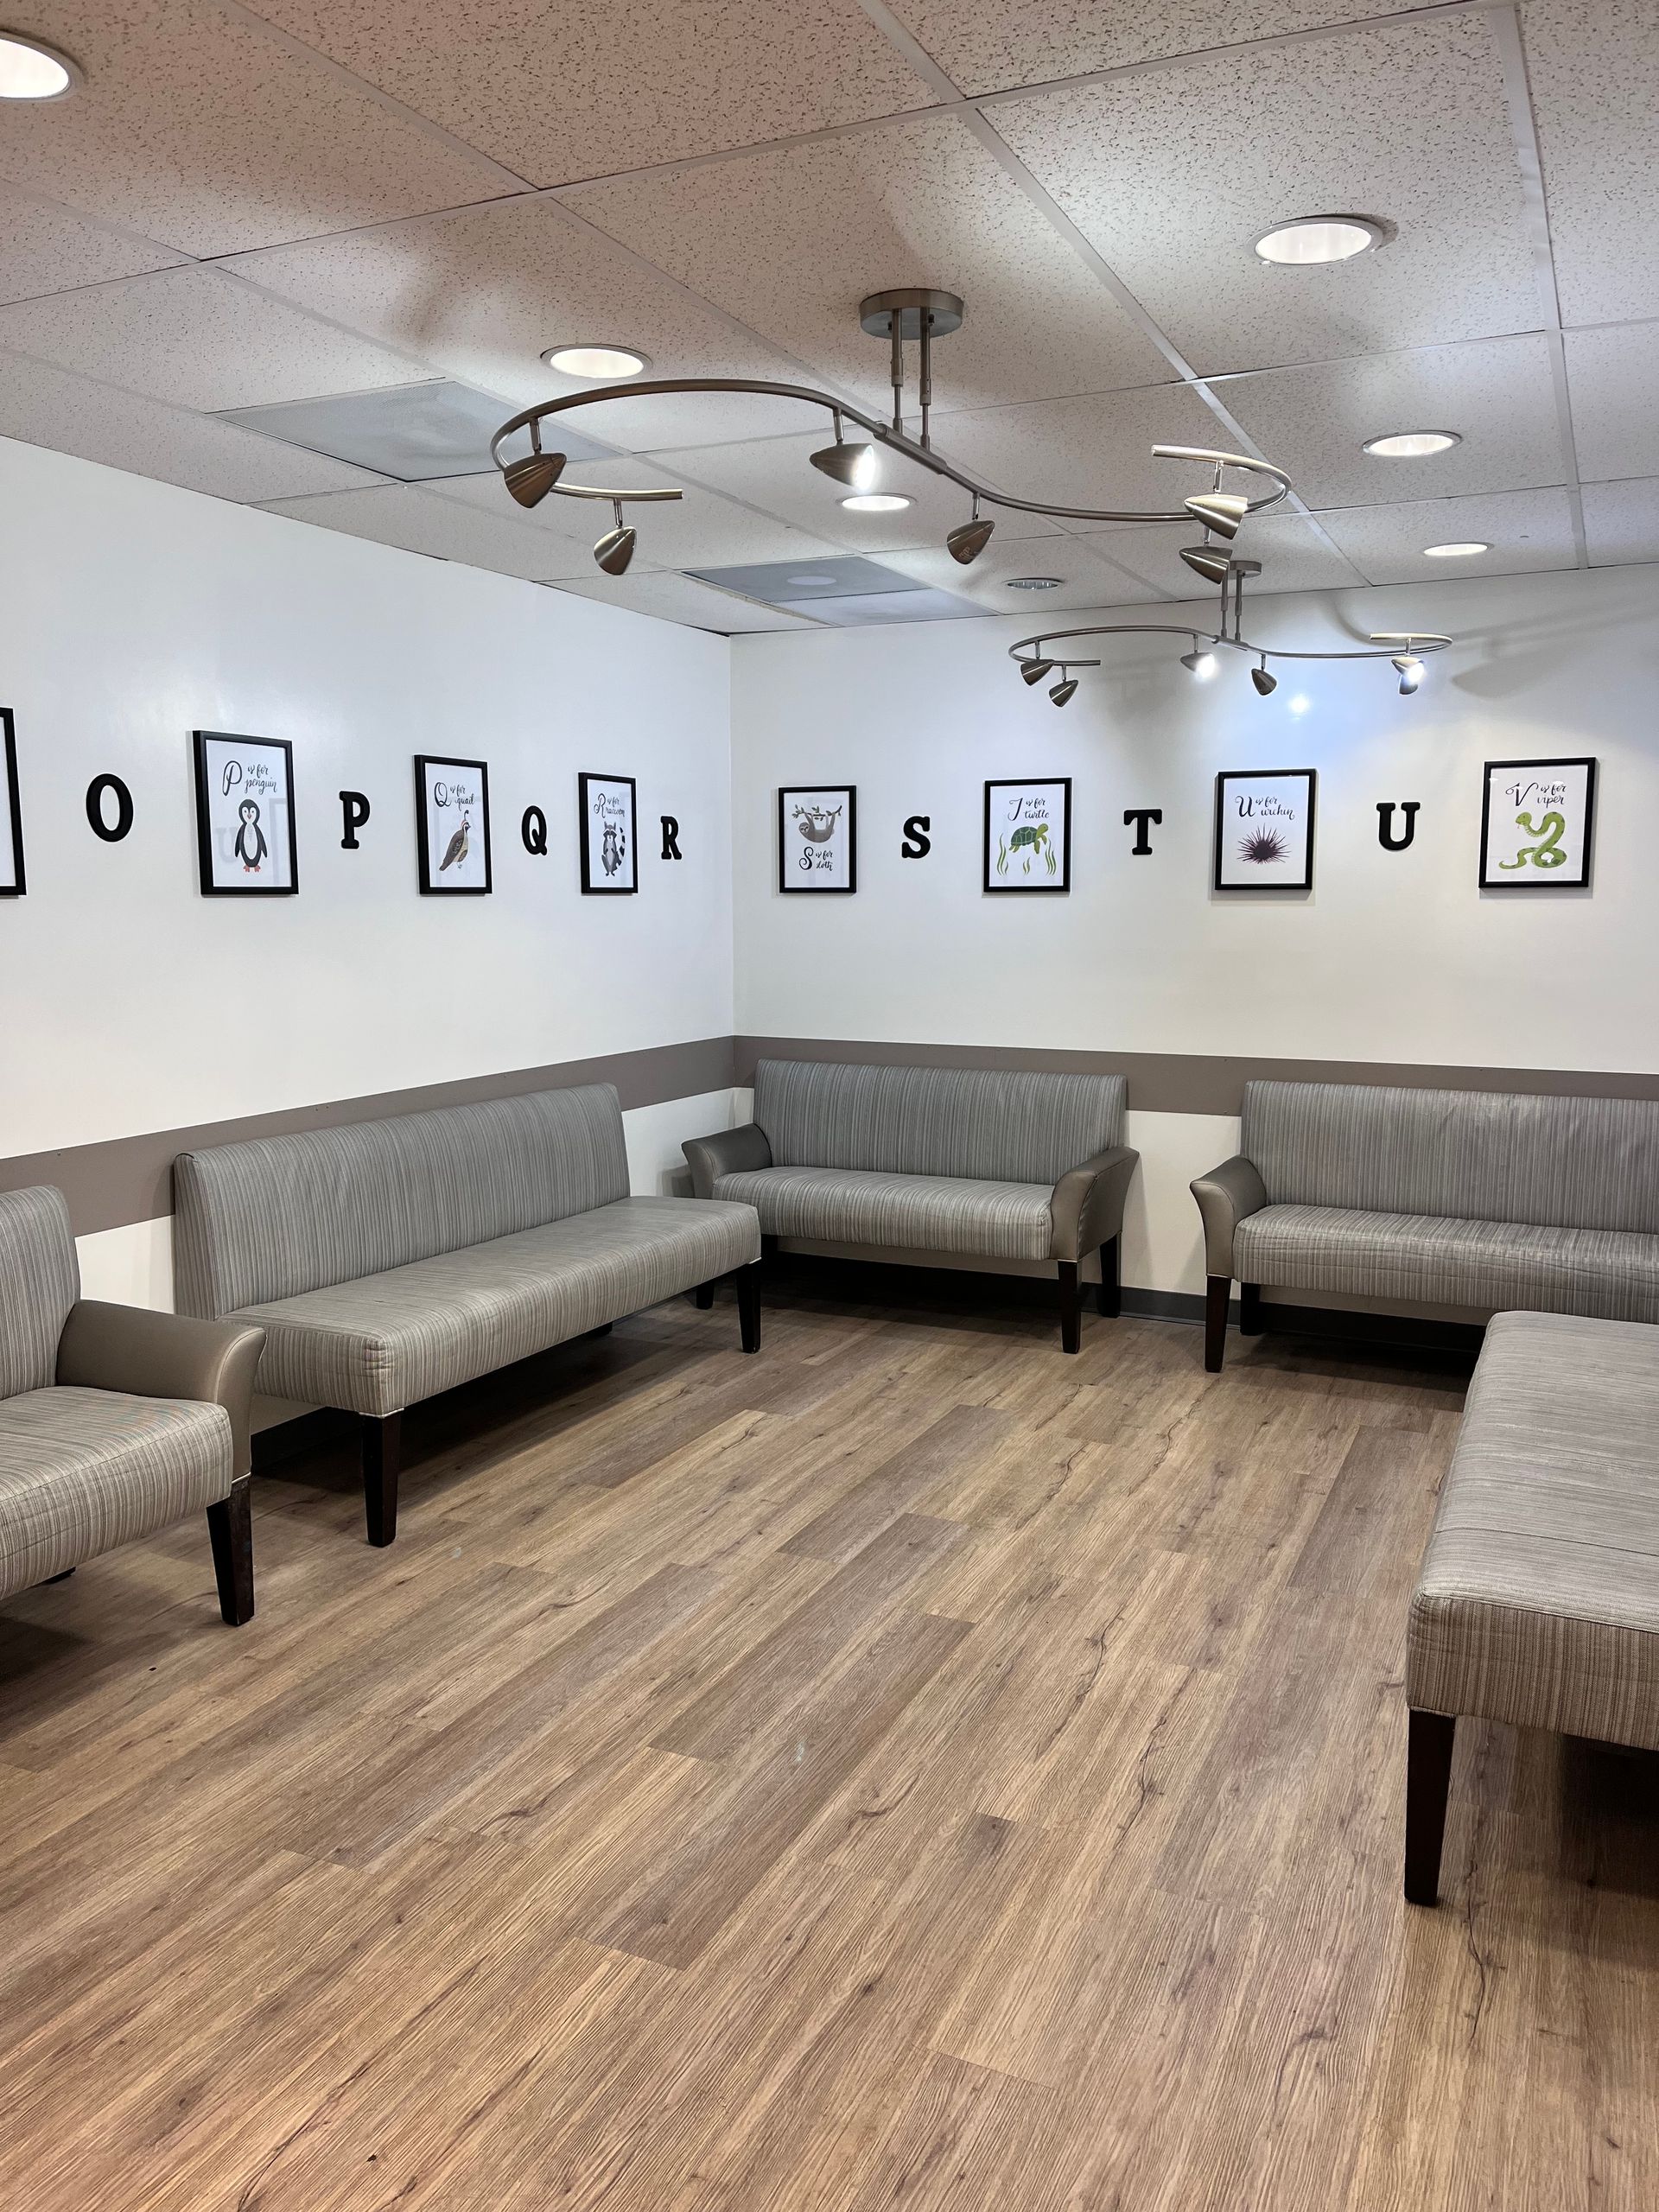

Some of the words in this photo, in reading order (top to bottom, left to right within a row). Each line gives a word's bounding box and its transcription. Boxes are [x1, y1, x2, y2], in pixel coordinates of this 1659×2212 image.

[222, 760, 242, 796] P
[247, 765, 255, 774] is
[257, 764, 269, 779] for
[245, 777, 276, 795] penguin
[434, 782, 452, 807] Q
[456, 785, 466, 797] for
[454, 793, 474, 811] quail
[594, 792, 606, 818] R
[1235, 795, 1255, 817] U
[1265, 796, 1277, 808] for
[1505, 782, 1538, 806] V
[1552, 783, 1567, 795] for
[1537, 796, 1564, 808] viper
[86, 773, 133, 842] O
[1007, 798, 1023, 821] T
[1034, 798, 1046, 809] for
[1024, 809, 1050, 819] turtle
[1261, 804, 1295, 820] urchin
[339, 791, 371, 849] P
[522, 805, 547, 855] Q
[1123, 809, 1162, 855] T
[1376, 802, 1421, 851] U
[660, 816, 682, 860] R
[902, 816, 931, 859] S
[798, 846, 814, 870] S
[823, 850, 833, 861] for
[816, 861, 833, 871] sloth
